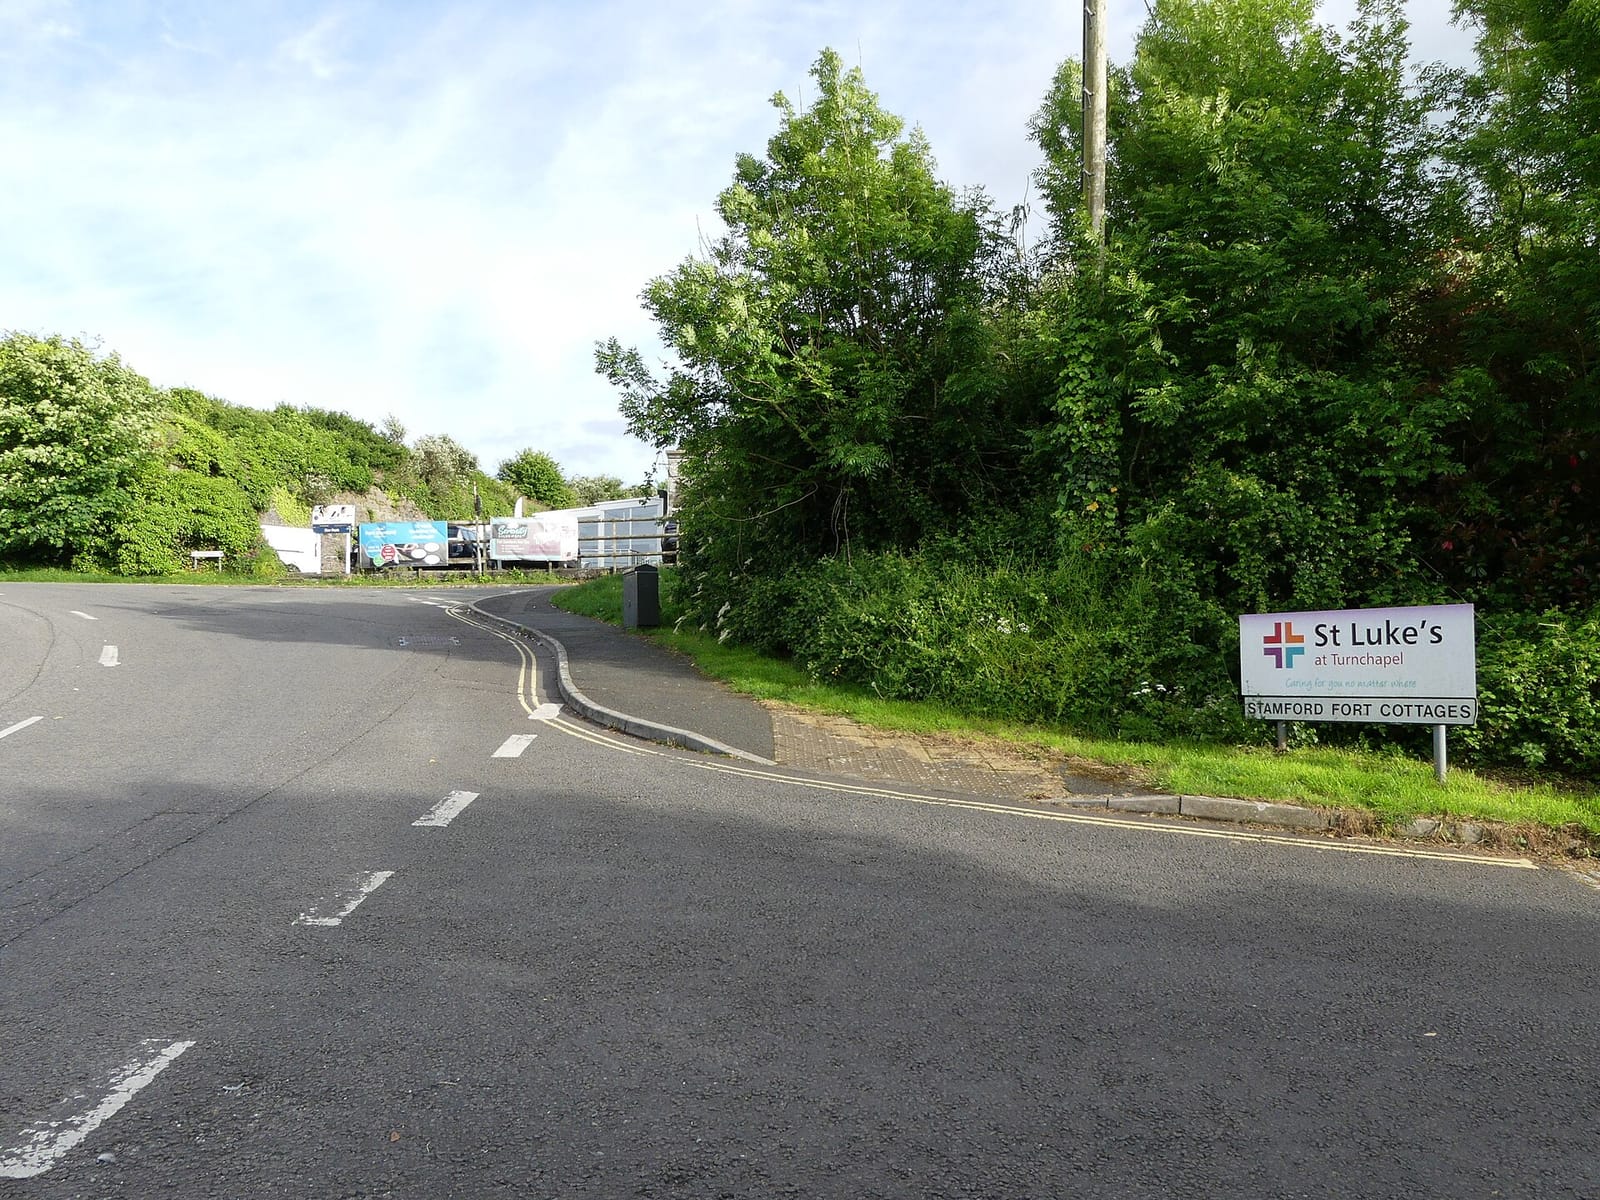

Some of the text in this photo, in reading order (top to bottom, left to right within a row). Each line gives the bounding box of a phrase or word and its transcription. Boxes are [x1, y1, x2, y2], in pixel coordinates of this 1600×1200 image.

[1315, 619, 1443, 647] St Luke's
[1314, 651, 1404, 668] at Turnchapel
[1285, 677, 1416, 691] Caring for you no matter where
[1247, 702, 1471, 719] STAMFORD FORT COTTAGES
